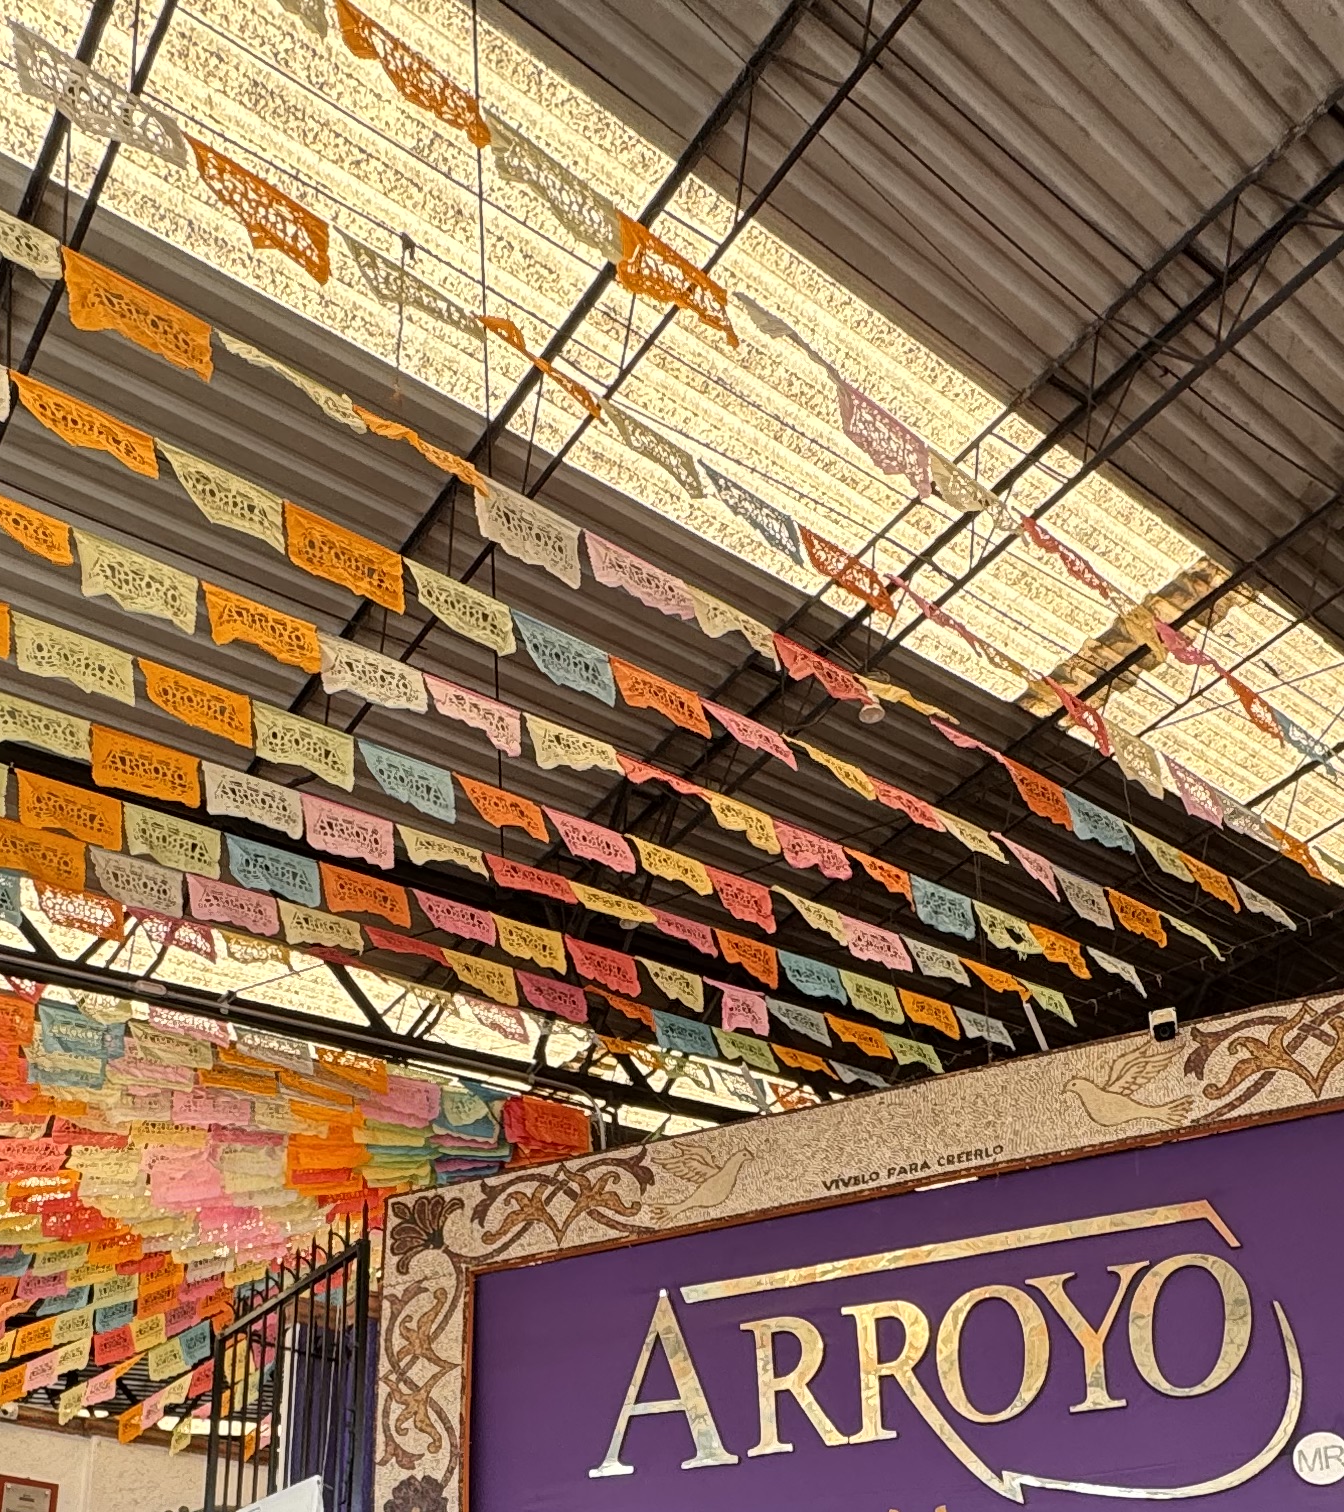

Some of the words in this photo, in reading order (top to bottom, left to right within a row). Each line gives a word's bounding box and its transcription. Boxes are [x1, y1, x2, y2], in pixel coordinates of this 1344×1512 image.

[821, 1171, 881, 1192] VÍVELO
[887, 1160, 931, 1184] PARA
[937, 1144, 1004, 1168] CREERLO
[589, 1253, 1251, 1503] ARROYO
